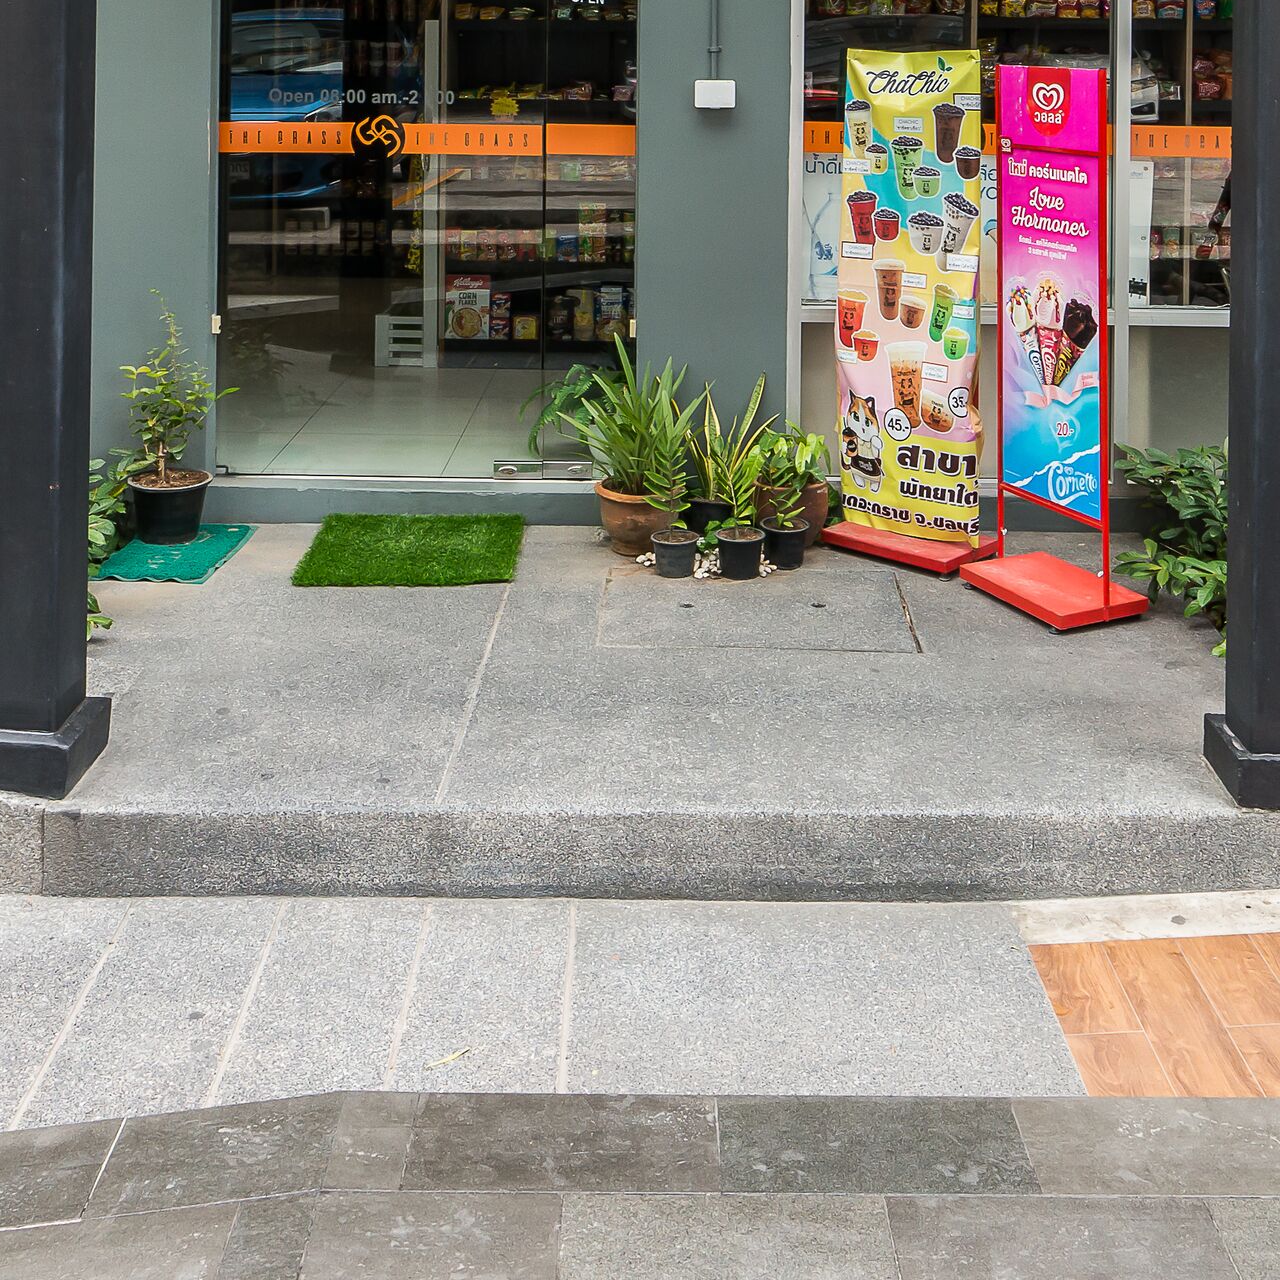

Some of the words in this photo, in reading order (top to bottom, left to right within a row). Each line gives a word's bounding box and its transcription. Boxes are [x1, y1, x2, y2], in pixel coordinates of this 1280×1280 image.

[865, 69, 950, 97] ChaChic
[268, 88, 315, 106] Open
[1033, 111, 1062, 124] วอลล์
[229, 130, 262, 145] THE
[416, 132, 449, 146] THE
[464, 132, 529, 148] GRASS
[1135, 133, 1169, 149] THE
[1008, 157, 1028, 177] ใหม่
[1028, 186, 1065, 211] Love
[1011, 205, 1089, 238] Hormones
[458, 291, 478, 300] CORN
[887, 417, 909, 432] 45.-
[1056, 422, 1075, 436] 20.-
[896, 444, 977, 478] สาขา
[1047, 463, 1098, 506] Cornetto
